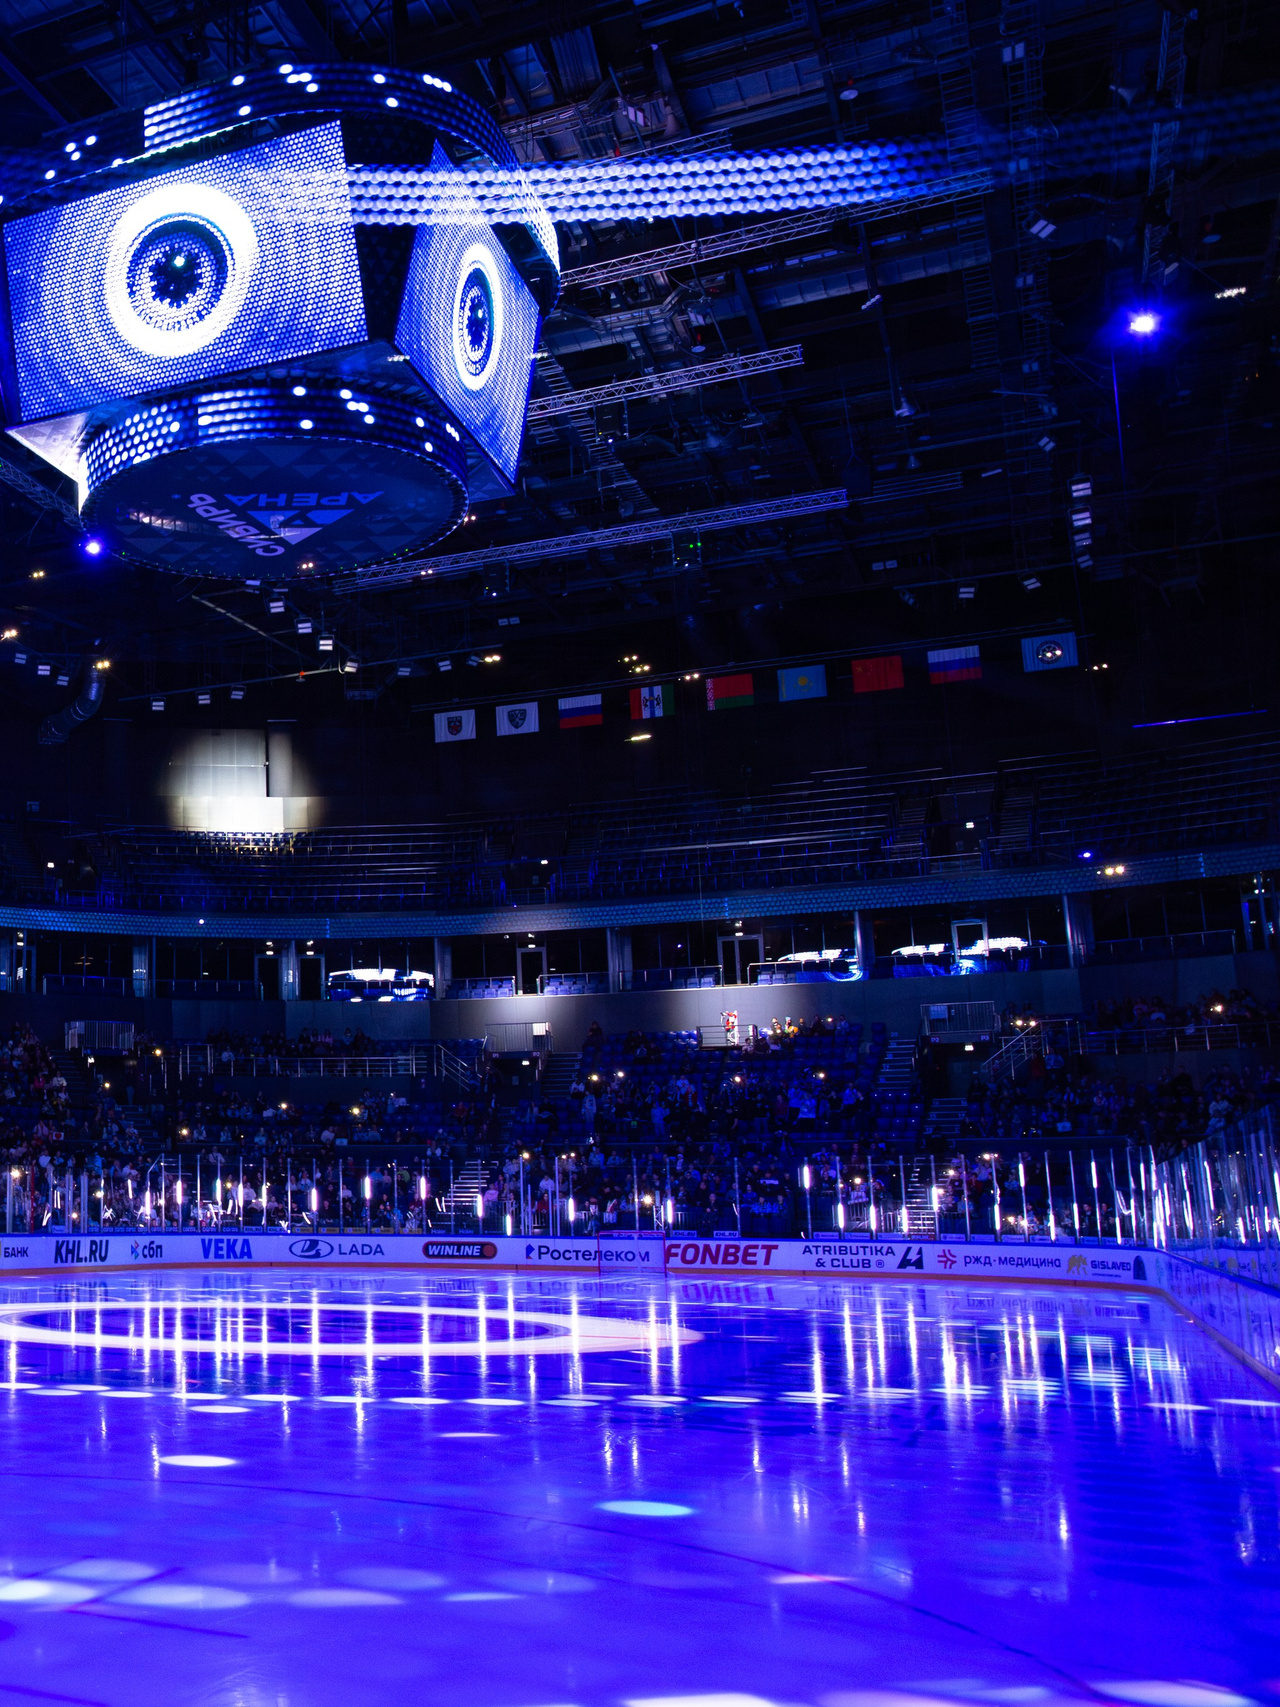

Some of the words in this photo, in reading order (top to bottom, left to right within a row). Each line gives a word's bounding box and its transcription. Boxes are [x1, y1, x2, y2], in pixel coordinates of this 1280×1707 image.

[224, 491, 384, 507] АРЕНА
[187, 493, 285, 557] СИБИРЬ
[4, 1247, 29, 1258] БАНК
[54, 1240, 109, 1264] KHL.RU
[201, 1239, 252, 1260] VEKA
[339, 1244, 385, 1256] LADA
[428, 1244, 481, 1257] WINLINE
[538, 1245, 650, 1263] Ростелеком
[666, 1243, 779, 1266] FONBET
[802, 1245, 896, 1257] ATRIBUTIKA
[815, 1258, 826, 1268] &
[831, 1258, 871, 1269] CLUB
[1090, 1260, 1132, 1272] GISLAVED
